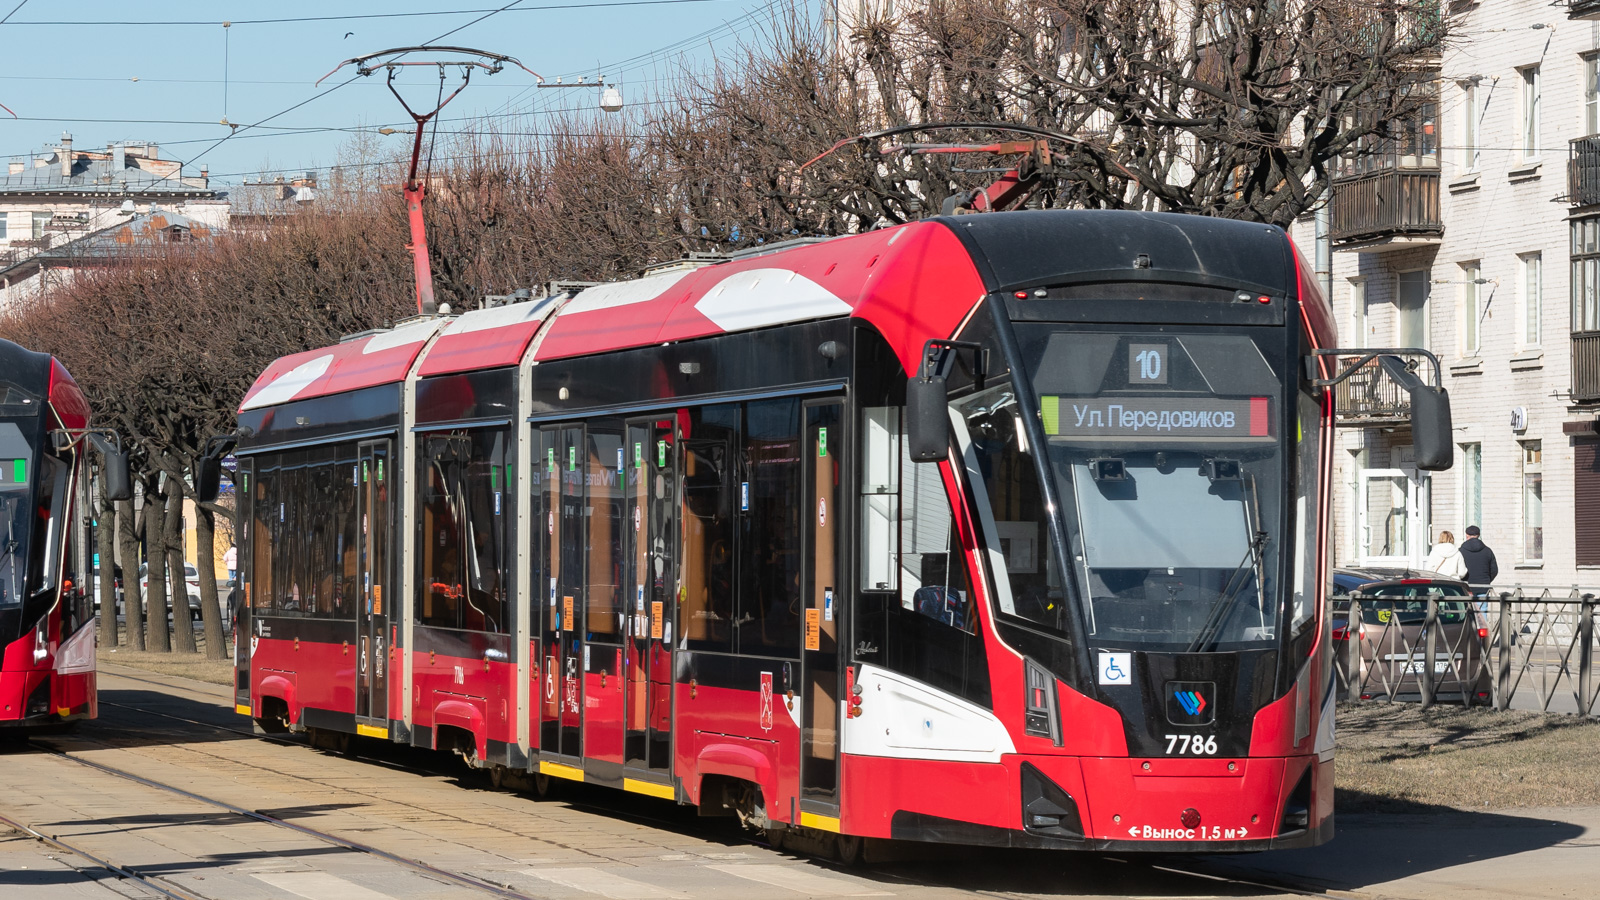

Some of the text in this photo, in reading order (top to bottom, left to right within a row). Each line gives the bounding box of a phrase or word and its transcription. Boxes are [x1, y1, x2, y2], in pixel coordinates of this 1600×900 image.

[1136, 350, 1161, 379] 10
[1165, 735, 1218, 755] 7786
[1142, 825, 1236, 840] Вынос 1,5 м
